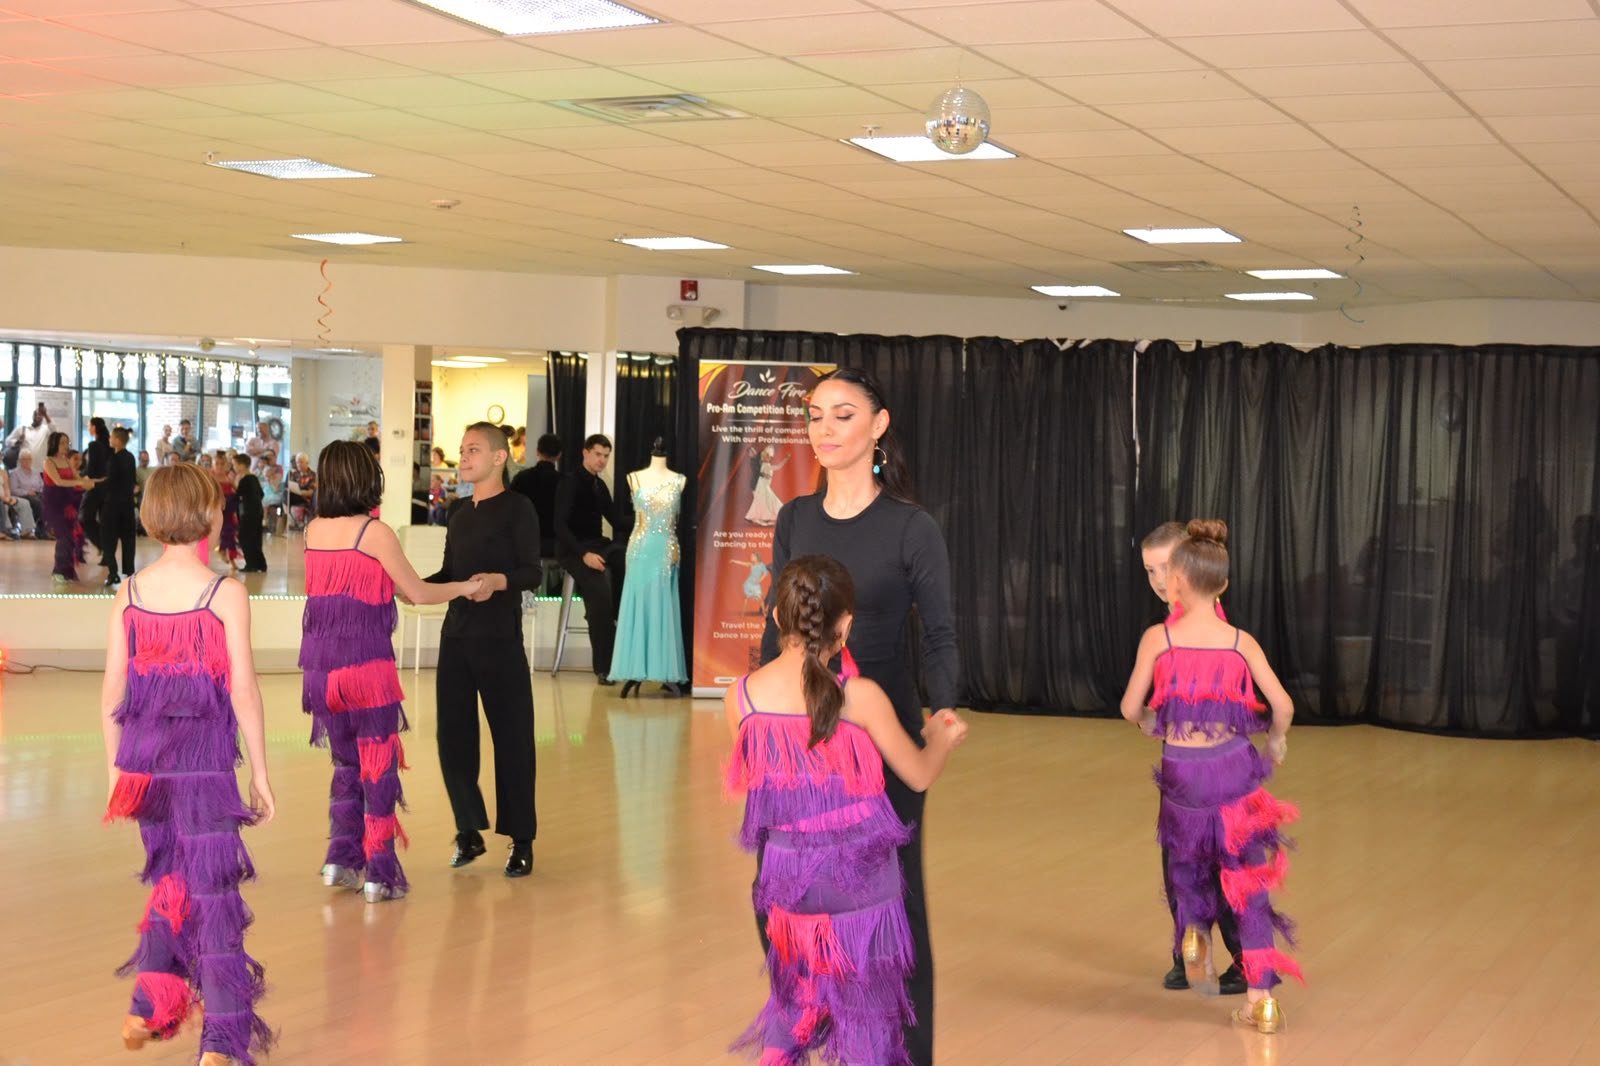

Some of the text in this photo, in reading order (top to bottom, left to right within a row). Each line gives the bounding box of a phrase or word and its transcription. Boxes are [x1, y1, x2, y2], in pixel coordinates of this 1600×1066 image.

[728, 381, 807, 400] Dance Fire
[706, 403, 804, 416] Pro-Am Competition Expe
[711, 425, 808, 435] Live the thrill of competi
[758, 436, 811, 445] Professionals
[713, 530, 727, 538] Are
[729, 531, 744, 539] you
[745, 530, 768, 539] ready
[713, 540, 747, 549] Dancing
[721, 621, 745, 629] Travel
[746, 621, 760, 629] the
[713, 631, 739, 639] Dance
